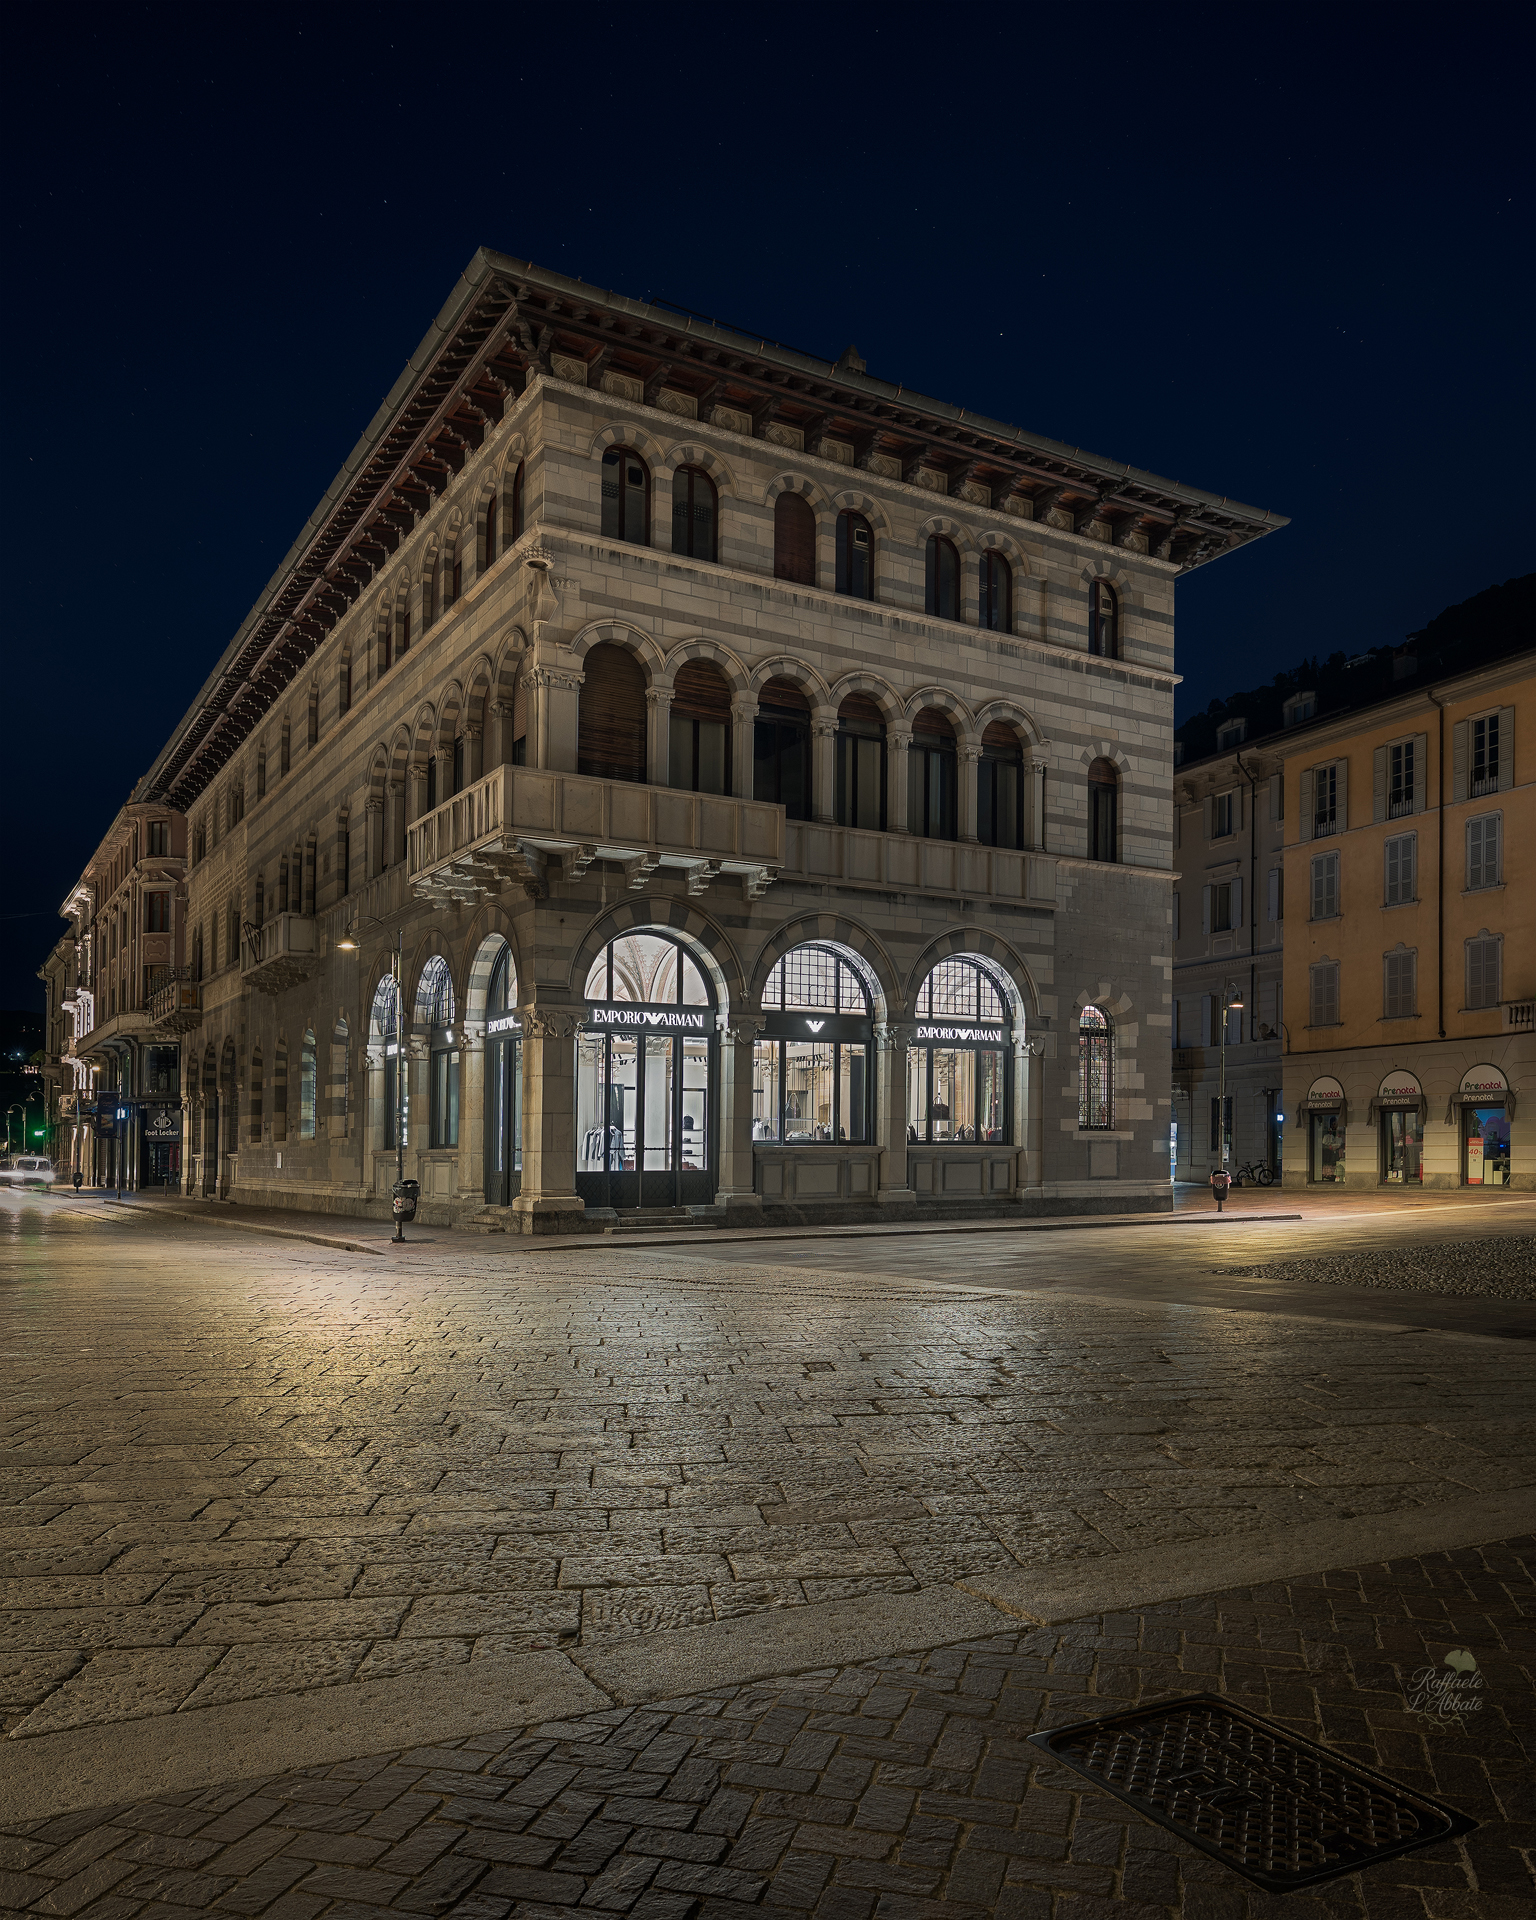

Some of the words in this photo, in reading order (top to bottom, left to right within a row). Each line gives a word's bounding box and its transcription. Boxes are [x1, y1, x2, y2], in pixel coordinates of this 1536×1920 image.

[593, 1009, 647, 1024] EMPORIO
[660, 1013, 704, 1027] ARMANI
[917, 1026, 958, 1039] EMPORIO
[968, 1029, 1002, 1041] ARMANI
